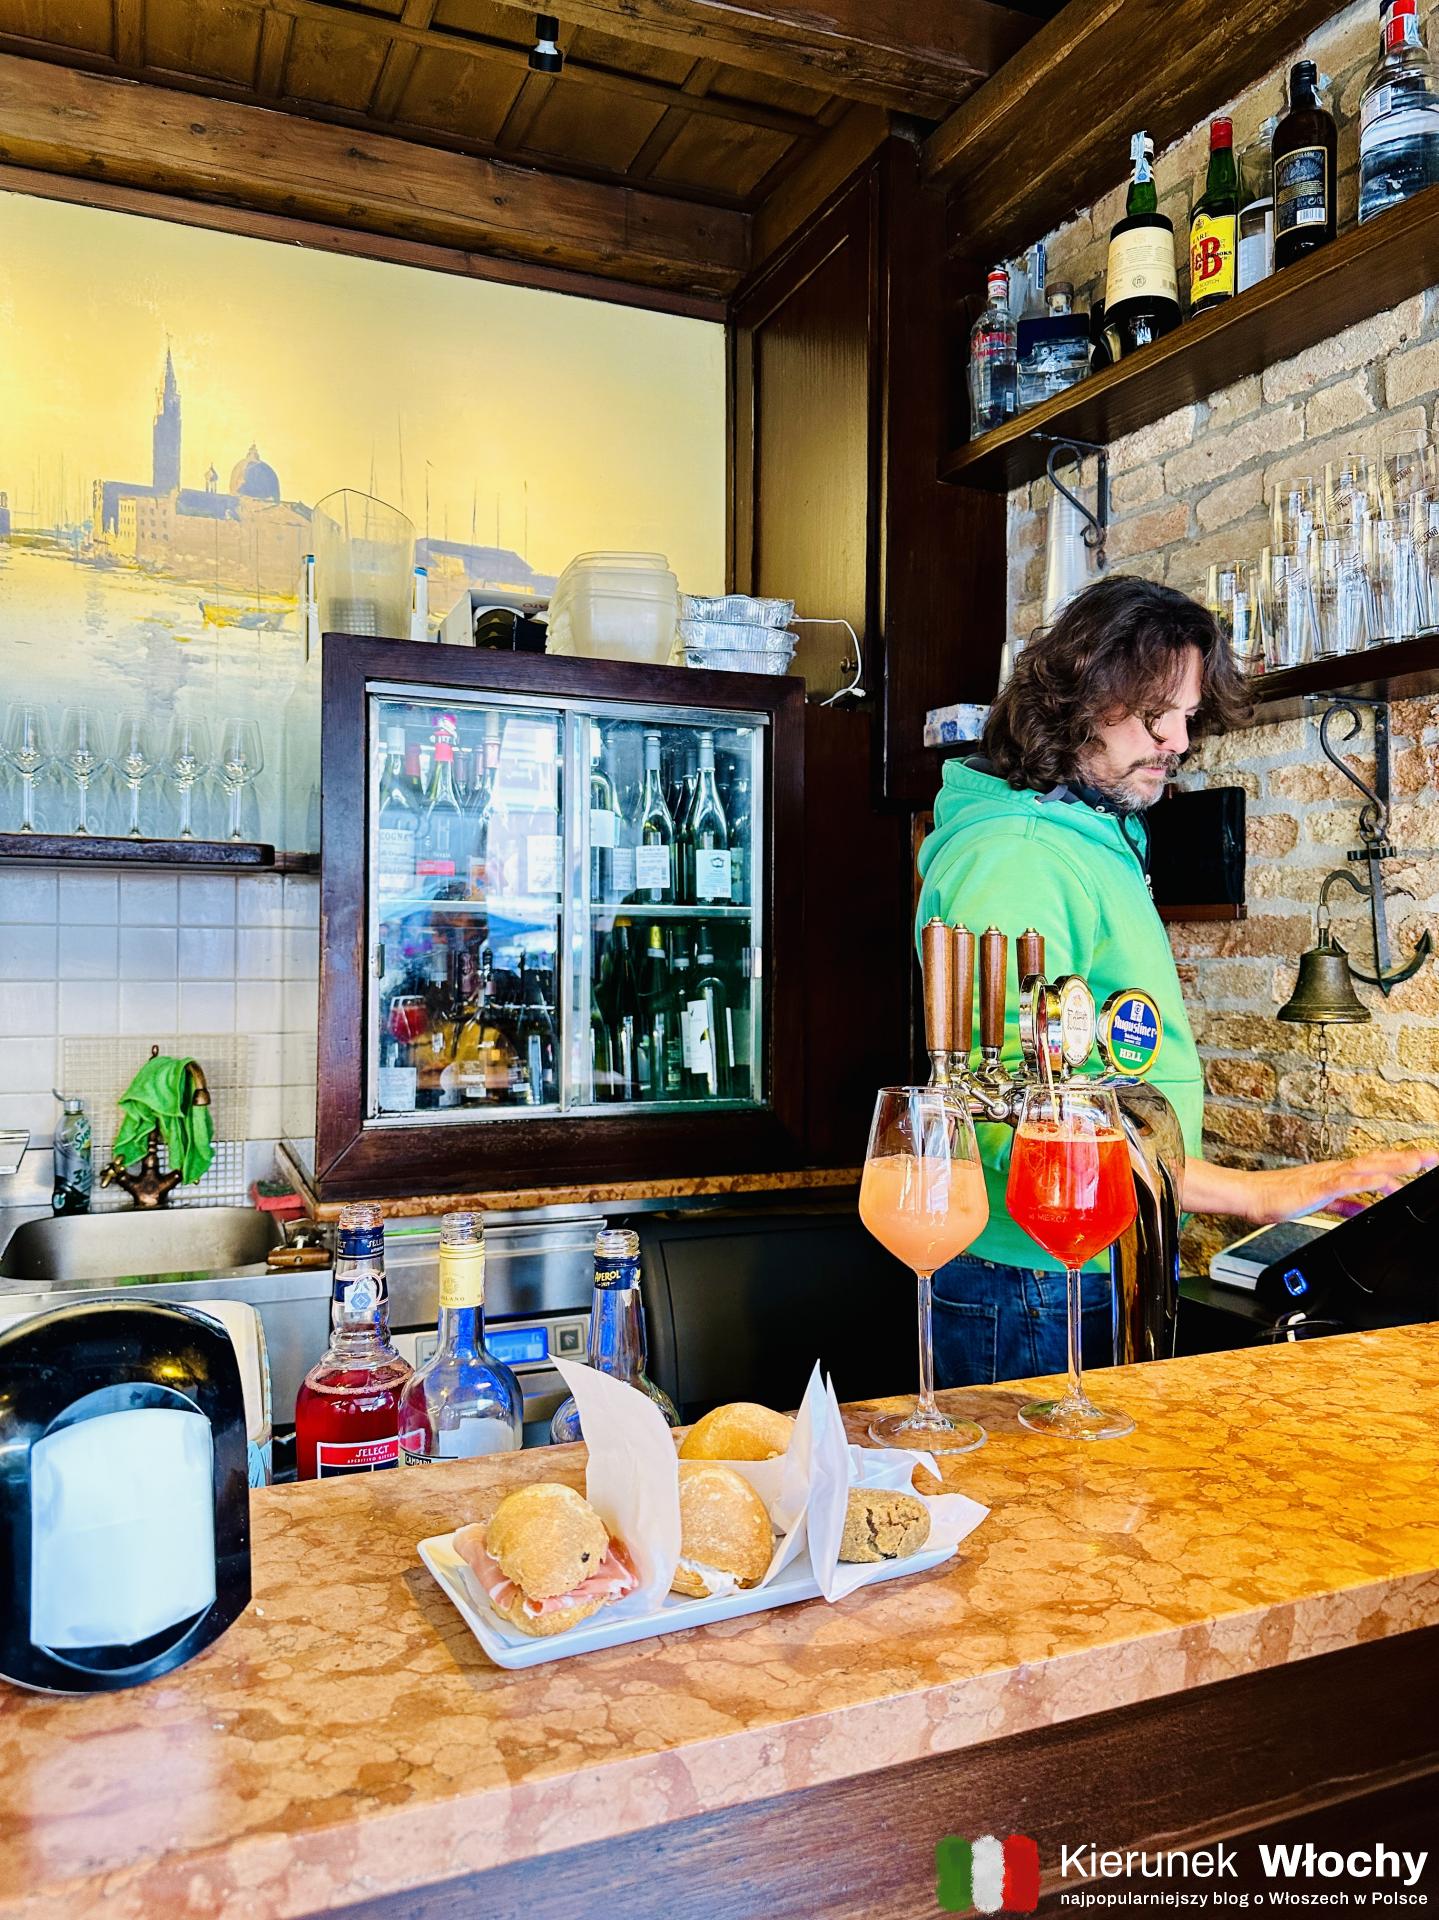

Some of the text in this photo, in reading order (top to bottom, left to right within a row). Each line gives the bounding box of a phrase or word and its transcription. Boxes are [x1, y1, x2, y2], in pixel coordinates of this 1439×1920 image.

[1113, 1014, 1158, 1038] Augustiner
[1119, 1047, 1143, 1063] HELL
[594, 1269, 622, 1282] APEROL
[355, 1444, 390, 1458] SELECT
